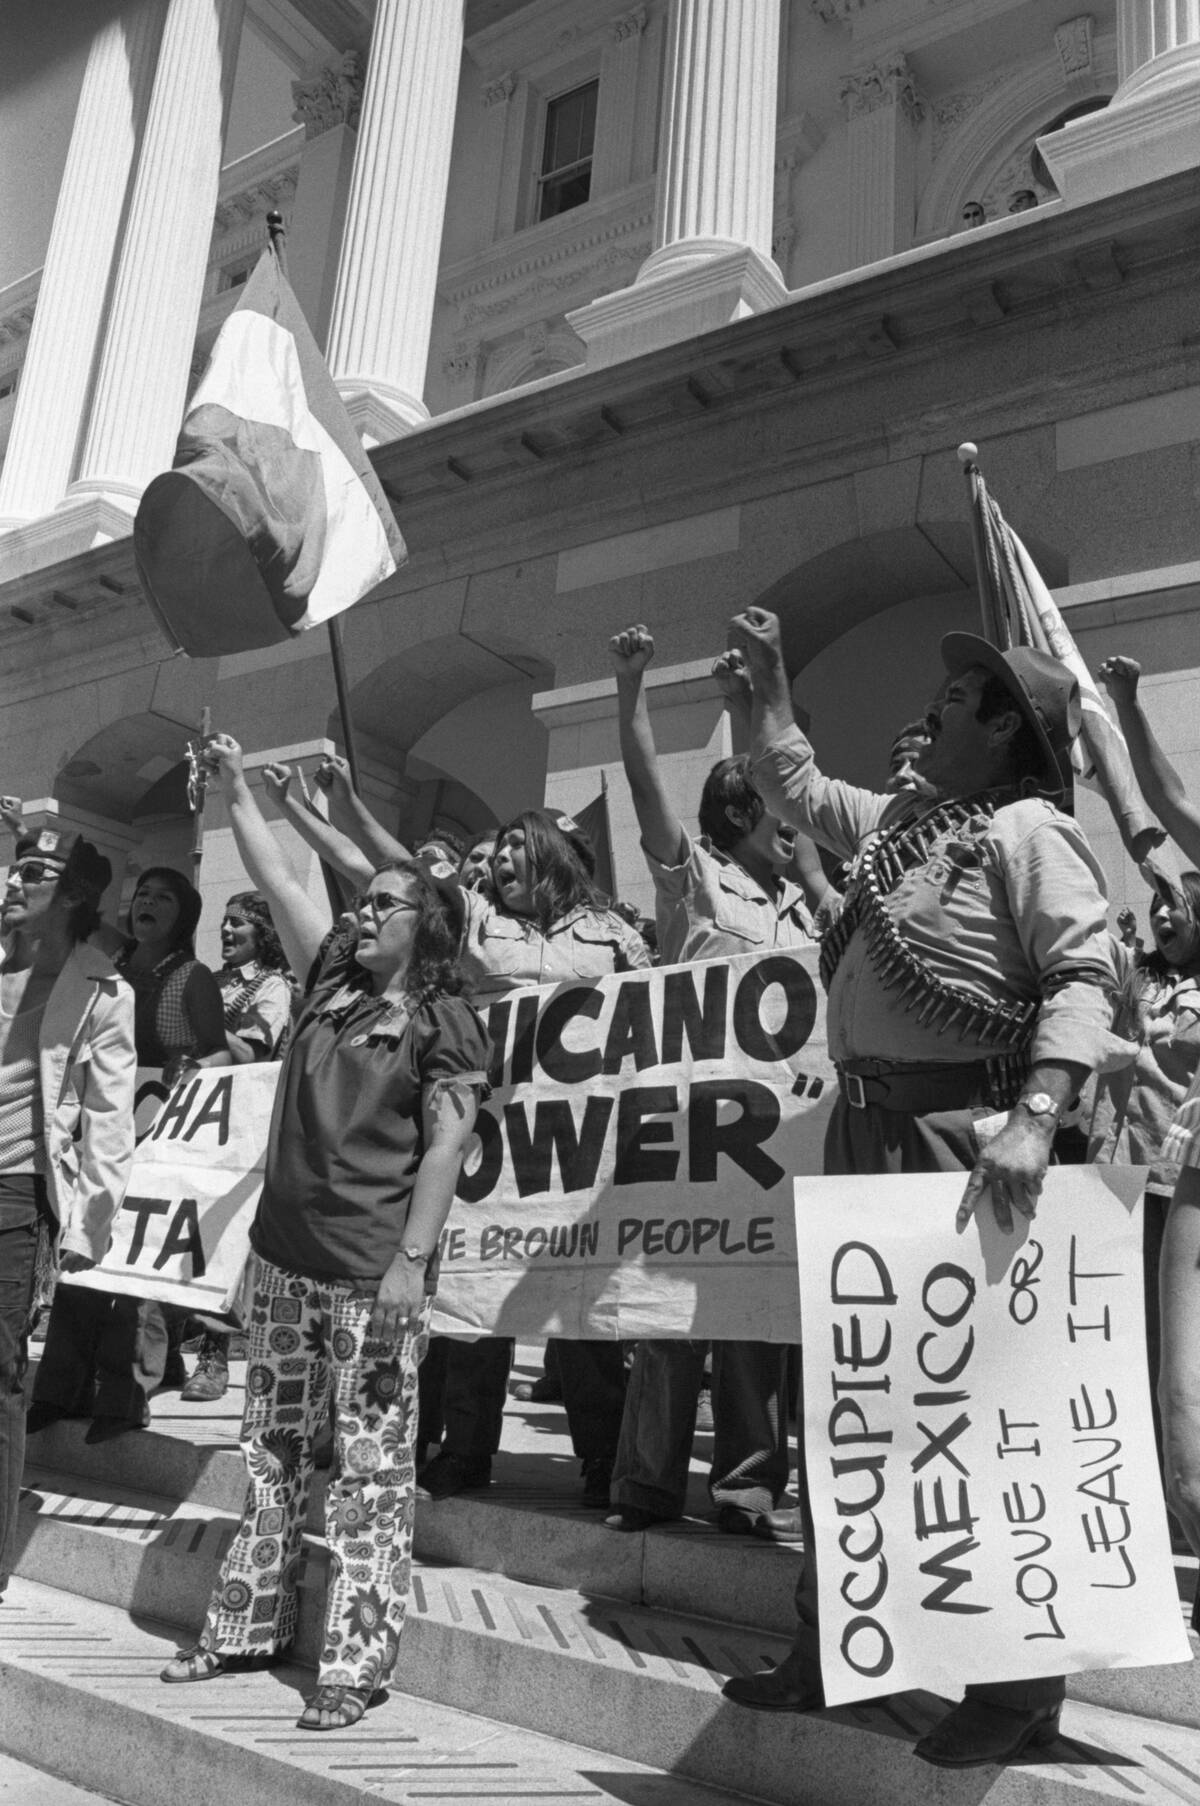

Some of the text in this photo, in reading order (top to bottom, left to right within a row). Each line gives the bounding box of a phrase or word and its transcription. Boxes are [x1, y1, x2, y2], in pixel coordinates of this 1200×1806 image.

[455, 1072, 825, 1203] OWER"
[487, 956, 817, 1086] ICANO
[108, 1196, 206, 1278] TA
[480, 1219, 600, 1261] BROWN
[618, 1216, 776, 1256] PEOPLE
[828, 1241, 898, 1678] OCCUPIED
[911, 1262, 994, 1614] MEXICO
[997, 1239, 1066, 1641] LOVE IT OR
[1067, 1234, 1138, 1589] LEAVE IT
